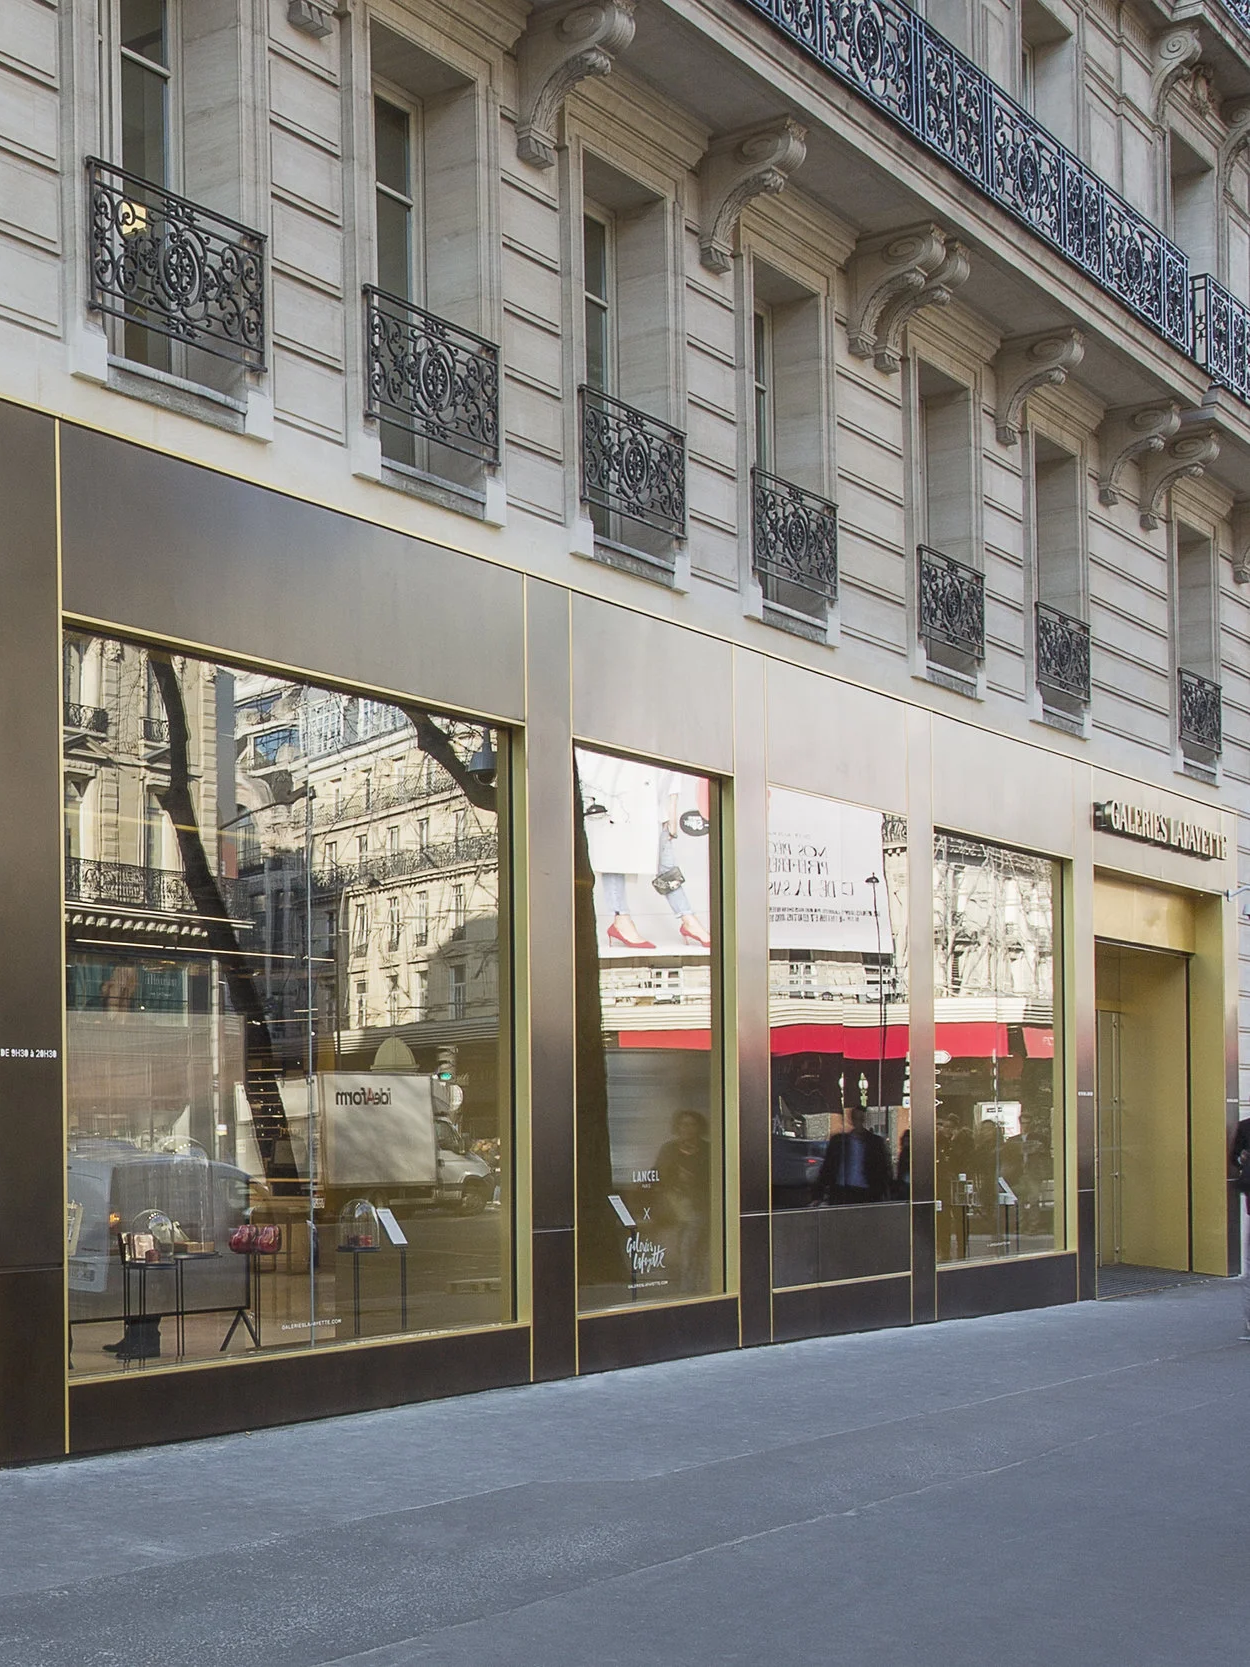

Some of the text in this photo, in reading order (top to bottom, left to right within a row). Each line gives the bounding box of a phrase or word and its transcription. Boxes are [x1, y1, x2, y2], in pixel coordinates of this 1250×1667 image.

[1105, 800, 1229, 860] GALERIES LAFAYETTE
[0, 1048, 10, 1058] DE
[11, 1049, 29, 1058] 9H30
[36, 1049, 57, 1059] 20H30
[632, 1170, 660, 1182] LANCEL
